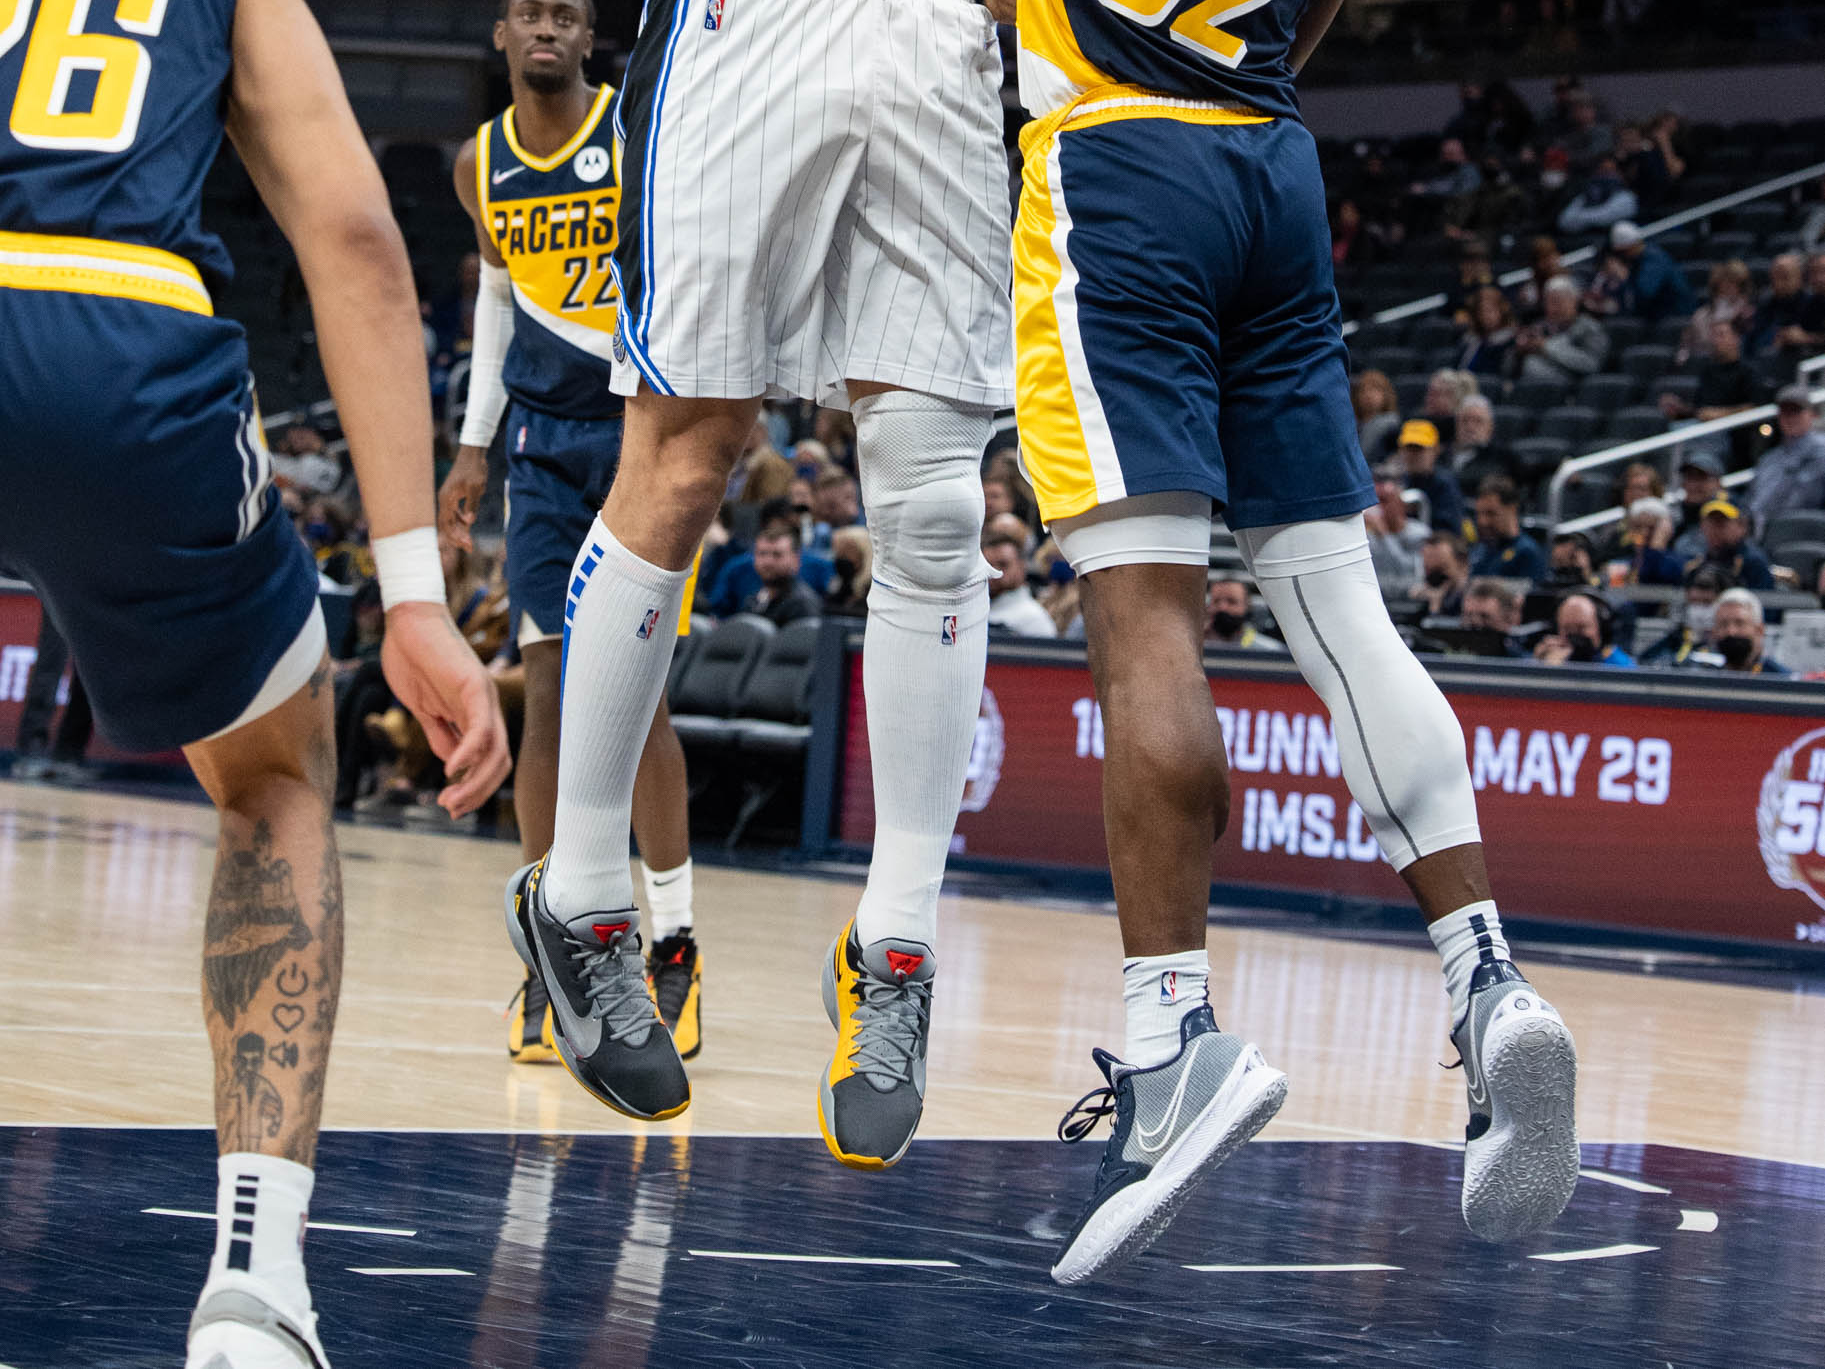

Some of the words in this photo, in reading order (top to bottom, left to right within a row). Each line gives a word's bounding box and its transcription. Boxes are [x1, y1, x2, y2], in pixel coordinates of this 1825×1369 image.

[494, 196, 615, 255] PACERS
[560, 254, 620, 313] 22
[1473, 725, 1590, 797] MAY
[1597, 735, 1672, 805] 29
[1242, 788, 1391, 864] IMS.C
